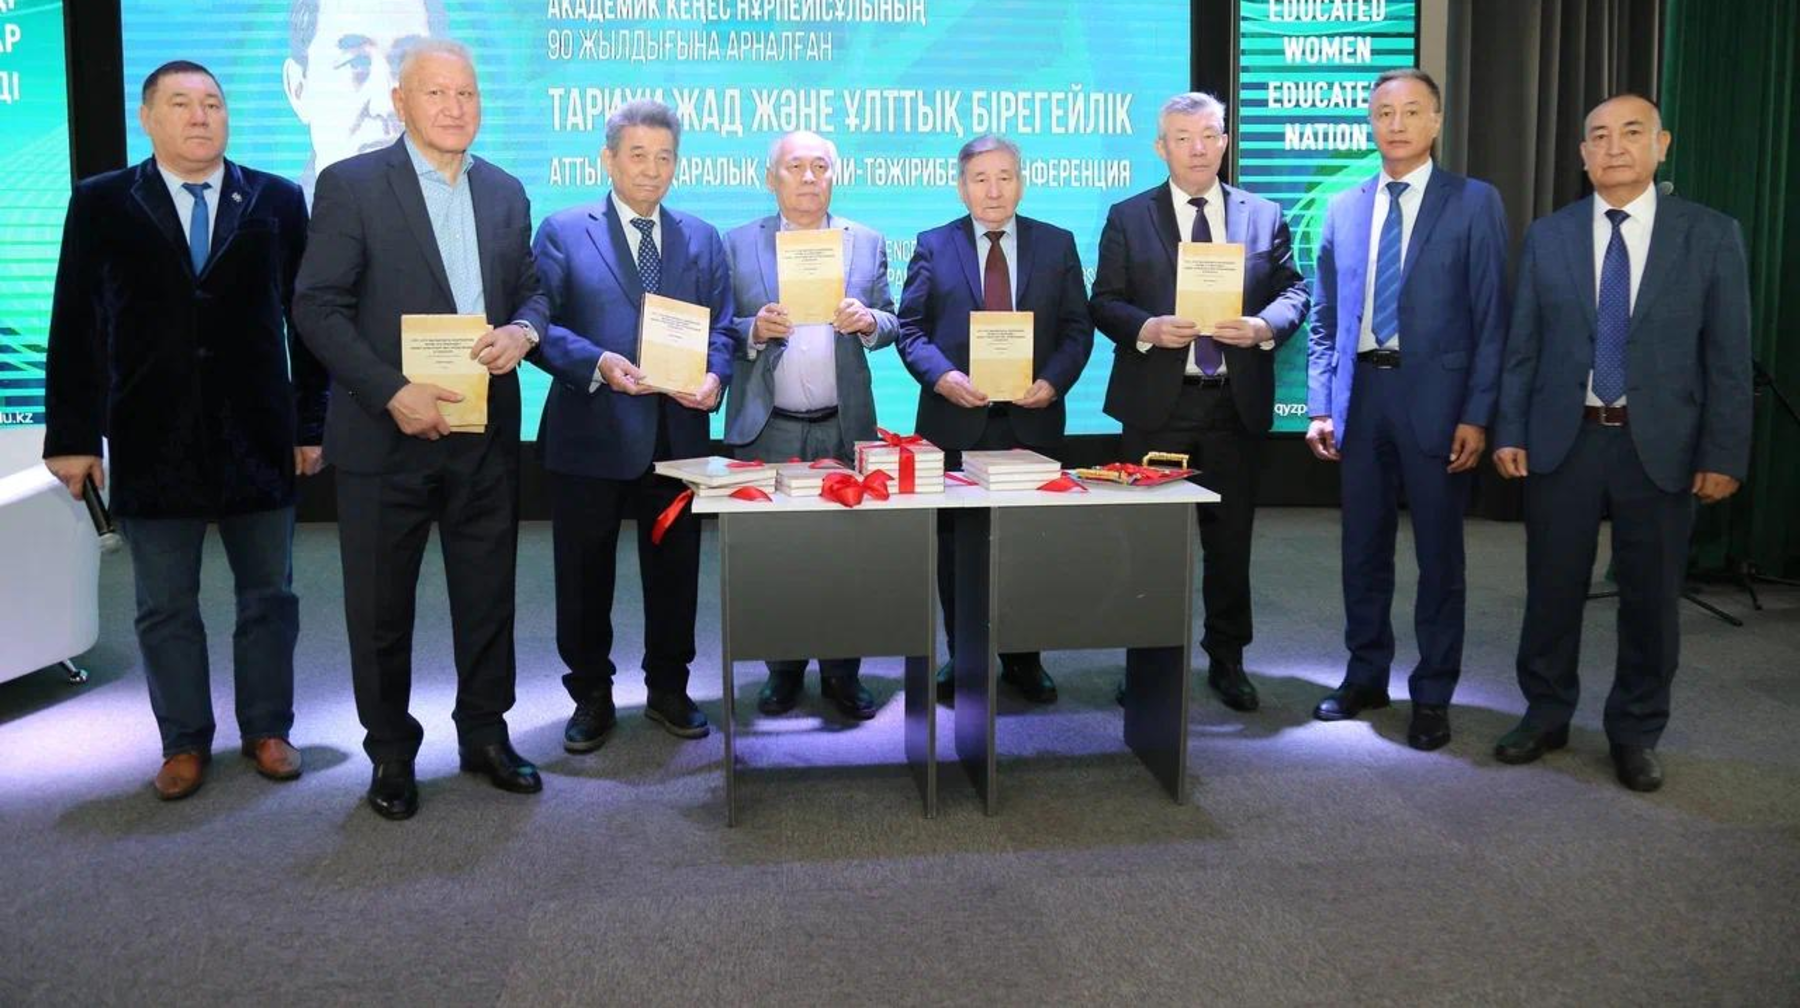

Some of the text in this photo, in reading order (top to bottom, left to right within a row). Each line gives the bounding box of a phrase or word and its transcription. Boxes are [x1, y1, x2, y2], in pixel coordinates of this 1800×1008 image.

[548, 0, 661, 22] АКАДЕМИК
[667, 0, 731, 23] КЕҢЕС
[1269, 0, 1386, 22] EDUCATED
[548, 29, 832, 64] 90 ЖЫЛДЫҒЫНА АРНАЛҒАН
[1283, 36, 1374, 64] WOMEN
[1268, 81, 1376, 108] EDUCATE
[672, 88, 743, 137] ЖАД
[751, 88, 835, 132] ЖӘНЕ
[843, 89, 963, 138] ҰЛТТЫҚ
[972, 83, 1133, 134] БІРЕГЕЙЛІК
[1284, 123, 1368, 151] NATION
[550, 157, 600, 187] АТТЫ
